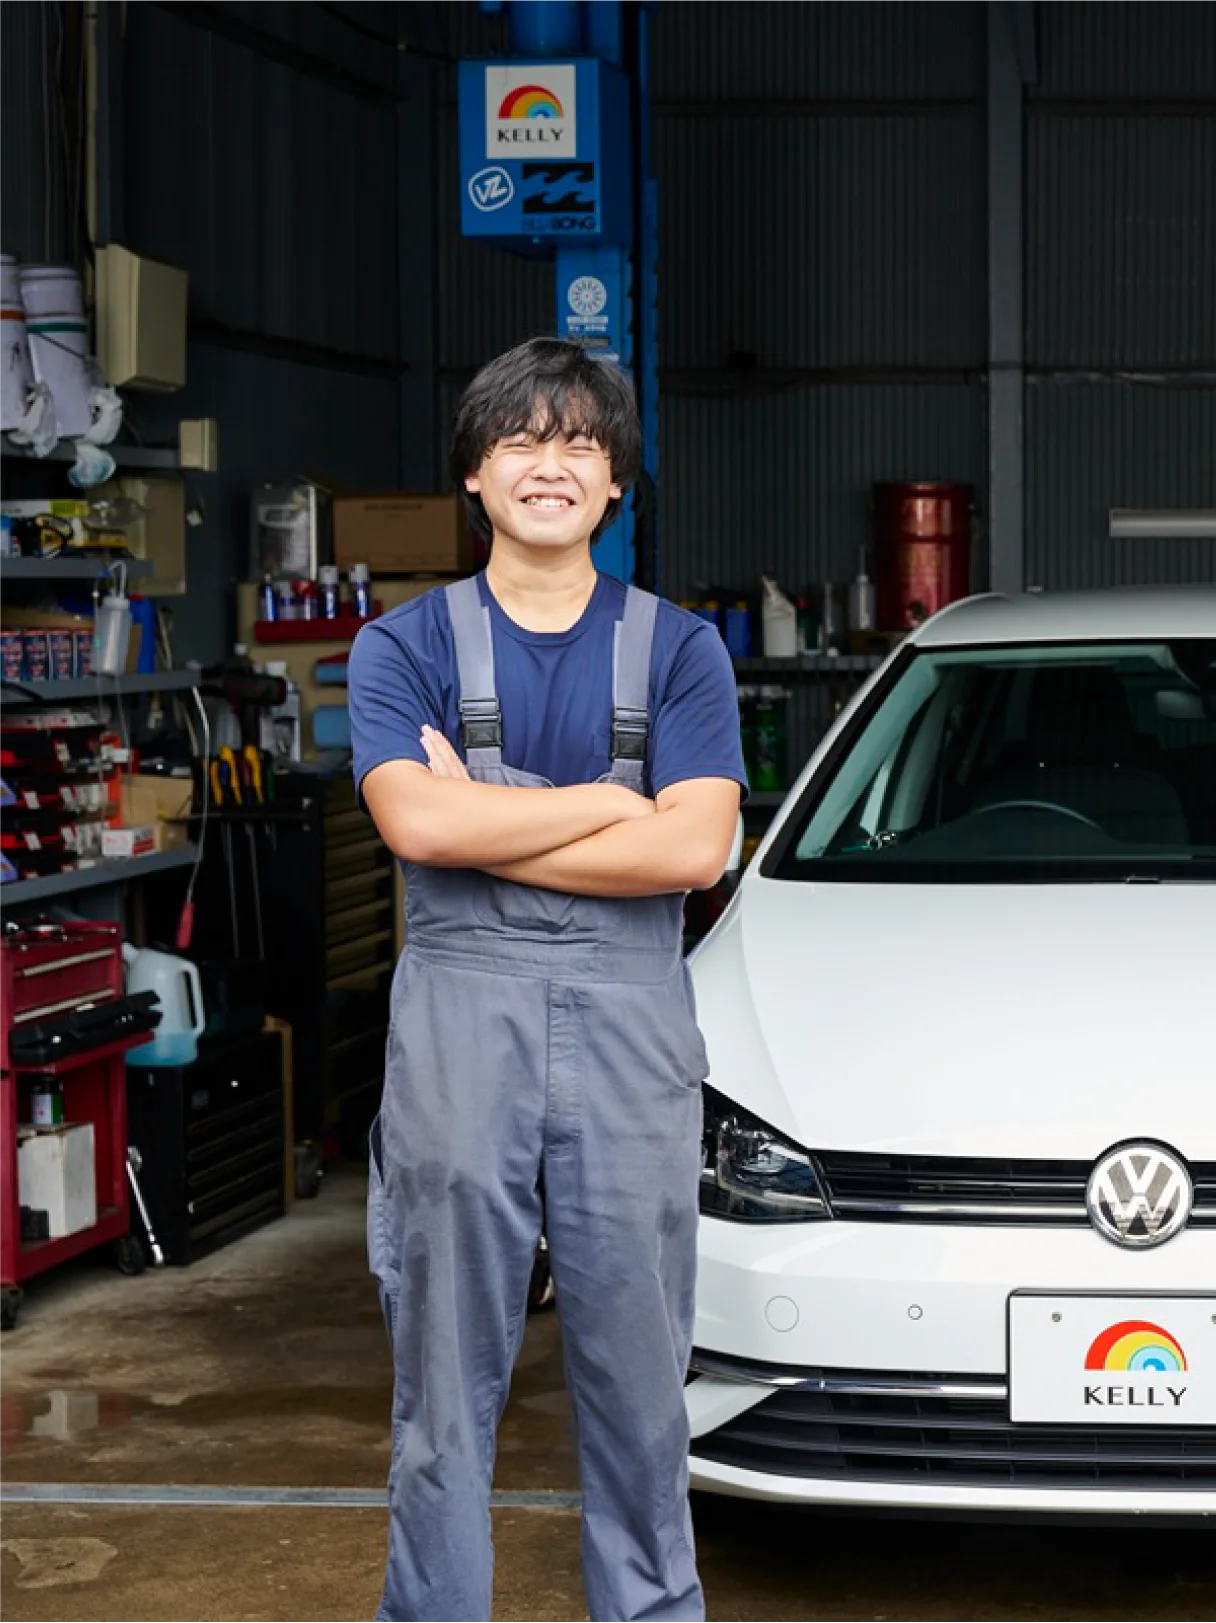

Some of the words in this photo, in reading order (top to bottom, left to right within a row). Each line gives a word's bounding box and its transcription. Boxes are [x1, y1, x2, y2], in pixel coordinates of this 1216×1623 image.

[497, 128, 563, 142] KELLY
[521, 216, 595, 231] ILBONG
[1096, 1148, 1184, 1238] VW
[1083, 1386, 1187, 1406] KELLY
